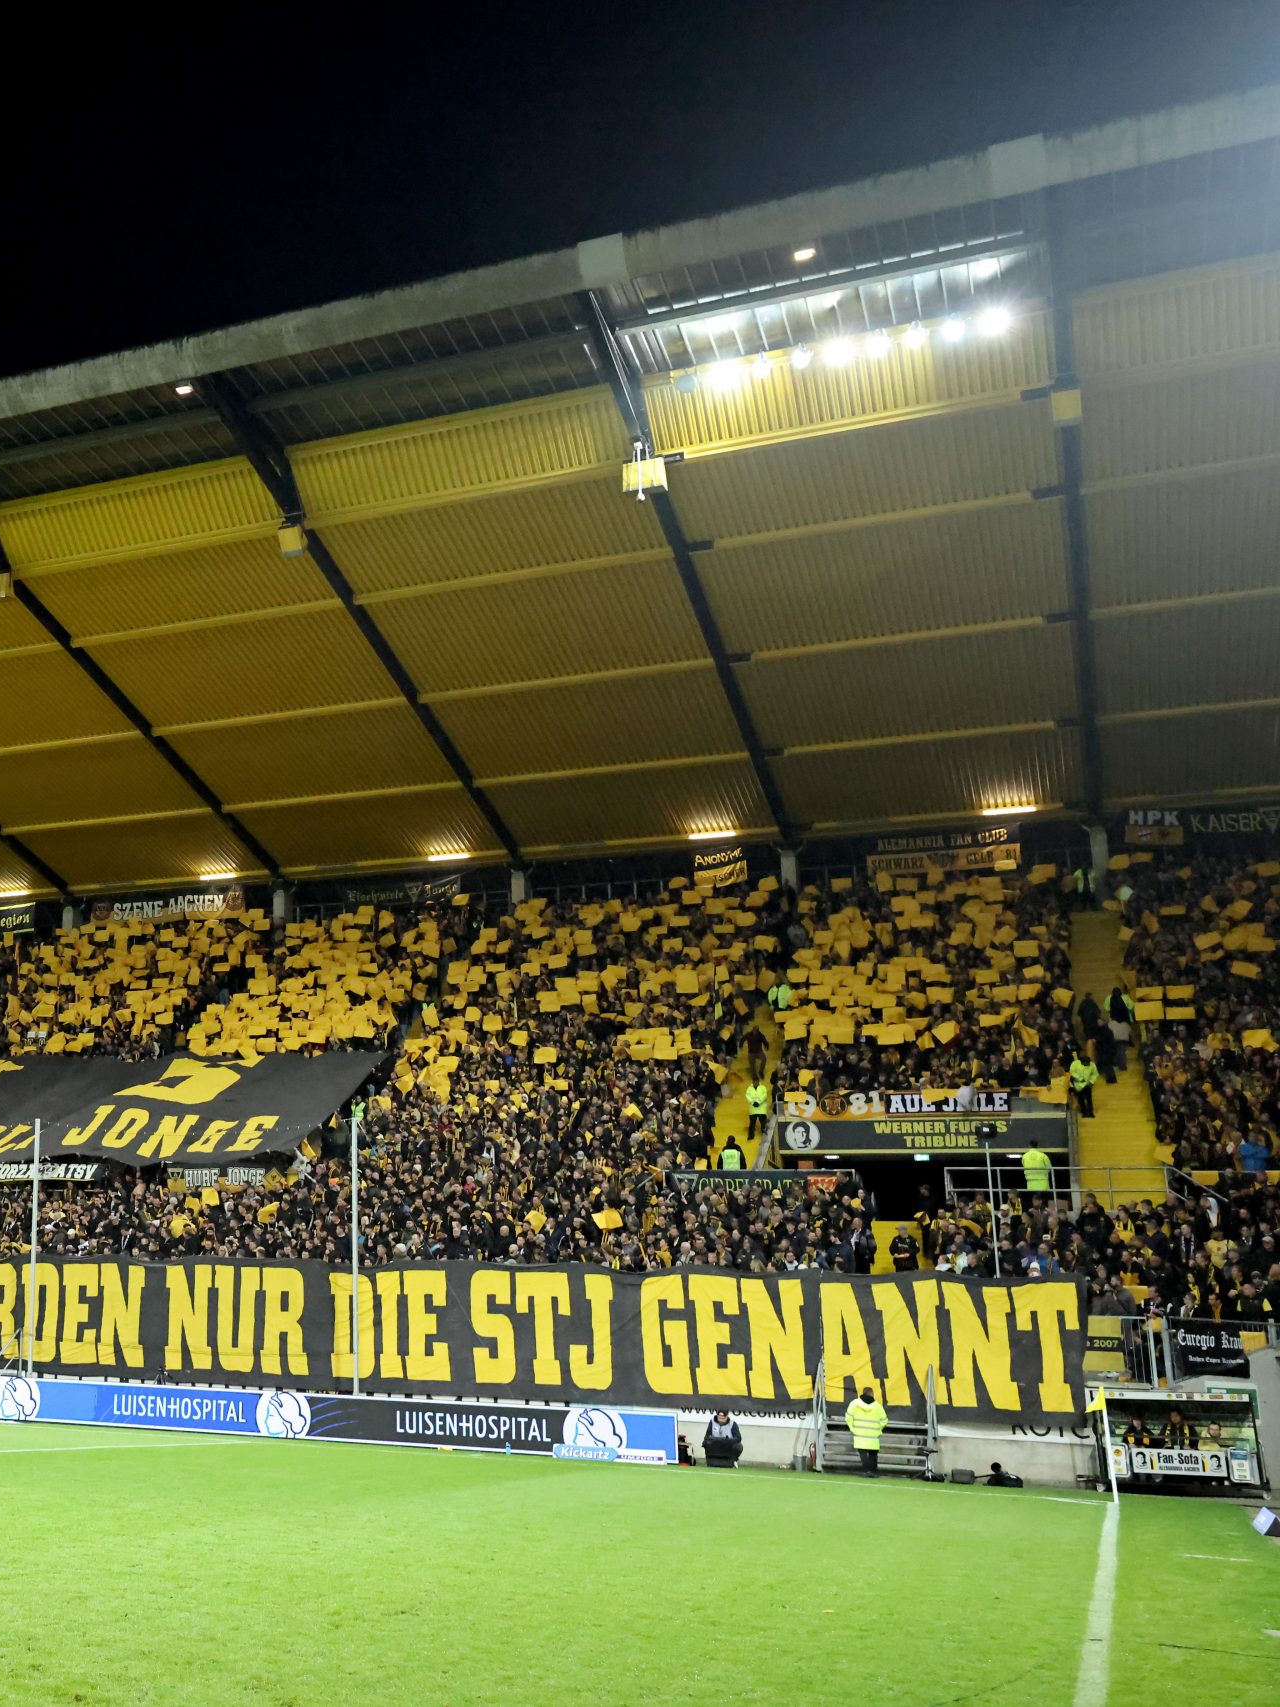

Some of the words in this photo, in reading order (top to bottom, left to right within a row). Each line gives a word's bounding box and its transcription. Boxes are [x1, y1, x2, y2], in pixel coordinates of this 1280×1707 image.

[1129, 810, 1180, 825] HPK
[878, 835, 944, 851] ALEMANNIA
[951, 834, 972, 845] FAN
[871, 857, 924, 870] SCHWARZ
[966, 851, 994, 865] GELB
[113, 901, 163, 920] SZENE
[168, 894, 224, 914] AACHEN
[849, 1091, 884, 1114] 81
[61, 1105, 280, 1158] JONGE
[874, 1121, 946, 1135] WERNER
[950, 1121, 1008, 1134] FUCS
[904, 1133, 979, 1148] TRIBÜNE
[225, 1167, 266, 1186] JONGE
[165, 1264, 309, 1376] NUR
[329, 1270, 451, 1381] DIE
[471, 1270, 613, 1391] STJ
[641, 1274, 1080, 1413] GENANNT
[1093, 1339, 1118, 1348] 2007
[1177, 1328, 1215, 1350] Euregio
[561, 1447, 609, 1459] Kickartz
[1157, 1452, 1199, 1465] Fan-Sofa
